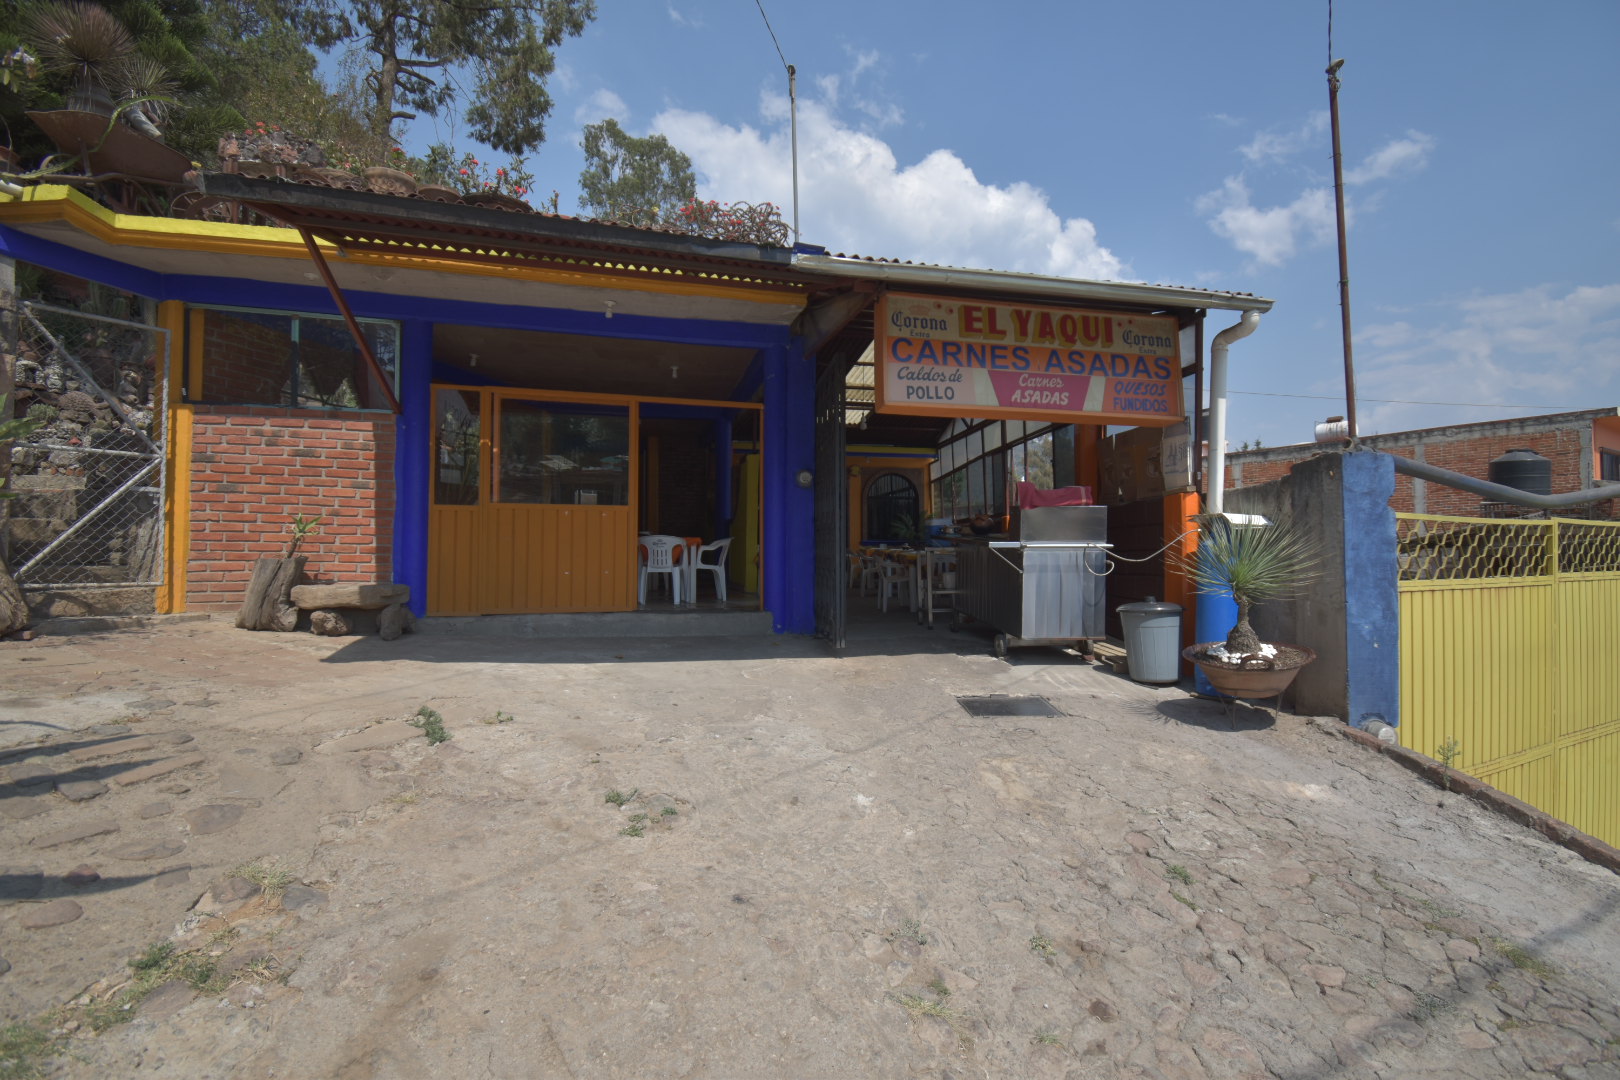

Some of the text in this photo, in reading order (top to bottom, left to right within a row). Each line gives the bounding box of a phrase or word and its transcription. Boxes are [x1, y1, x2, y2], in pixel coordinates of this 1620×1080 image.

[891, 311, 947, 331] Corona
[958, 305, 1114, 348] EL YAQUI
[1122, 330, 1171, 348] Corona
[892, 337, 1172, 380] CARNES ASADAS
[897, 366, 963, 383] Caldos de
[1018, 373, 1065, 388] Carnes
[906, 385, 954, 400] POLLO
[1011, 389, 1070, 406] ASADAS
[1114, 381, 1167, 397] QUESOS
[1113, 397, 1169, 413] FUNDIDOS
